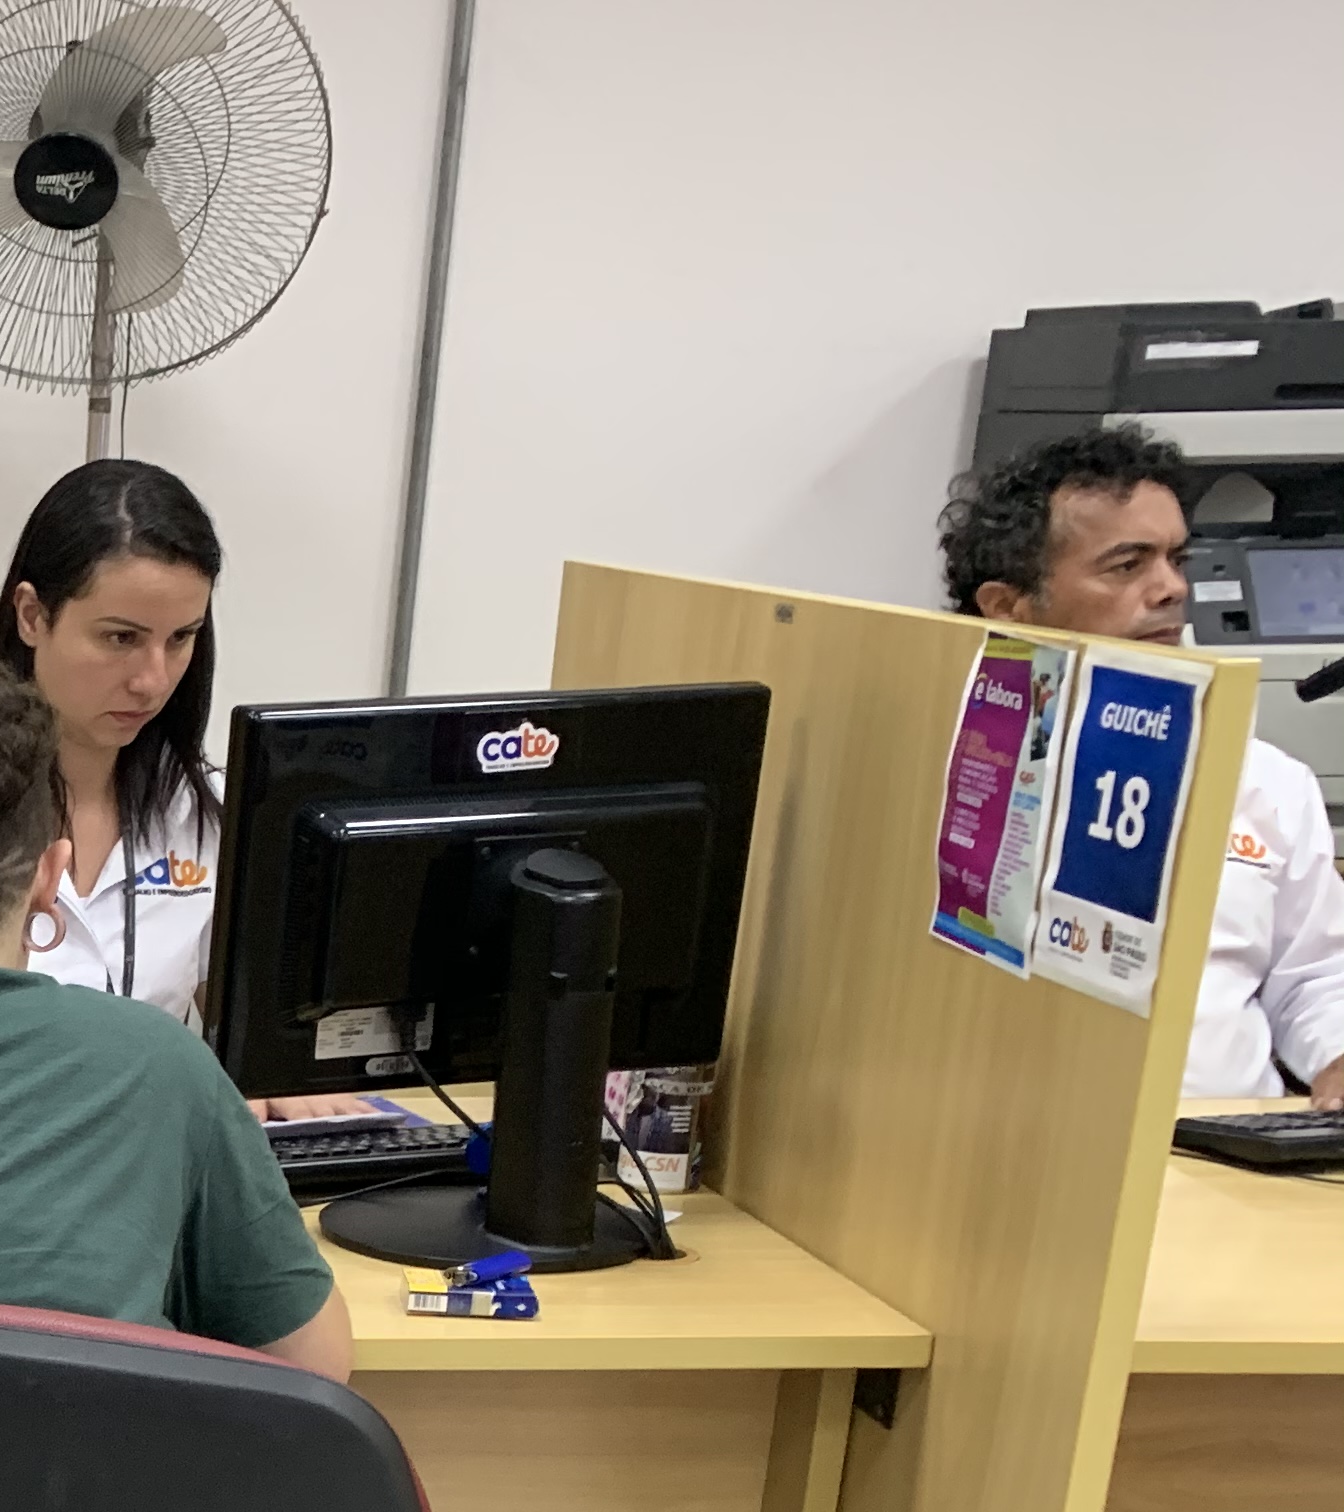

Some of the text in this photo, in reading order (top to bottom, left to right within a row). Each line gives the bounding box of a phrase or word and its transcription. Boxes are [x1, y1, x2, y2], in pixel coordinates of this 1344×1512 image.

[1100, 702, 1172, 741] GUICHÊ
[482, 728, 555, 762] cate
[1088, 770, 1150, 849] 18
[135, 849, 208, 888] ate
[1050, 916, 1090, 953] cate
